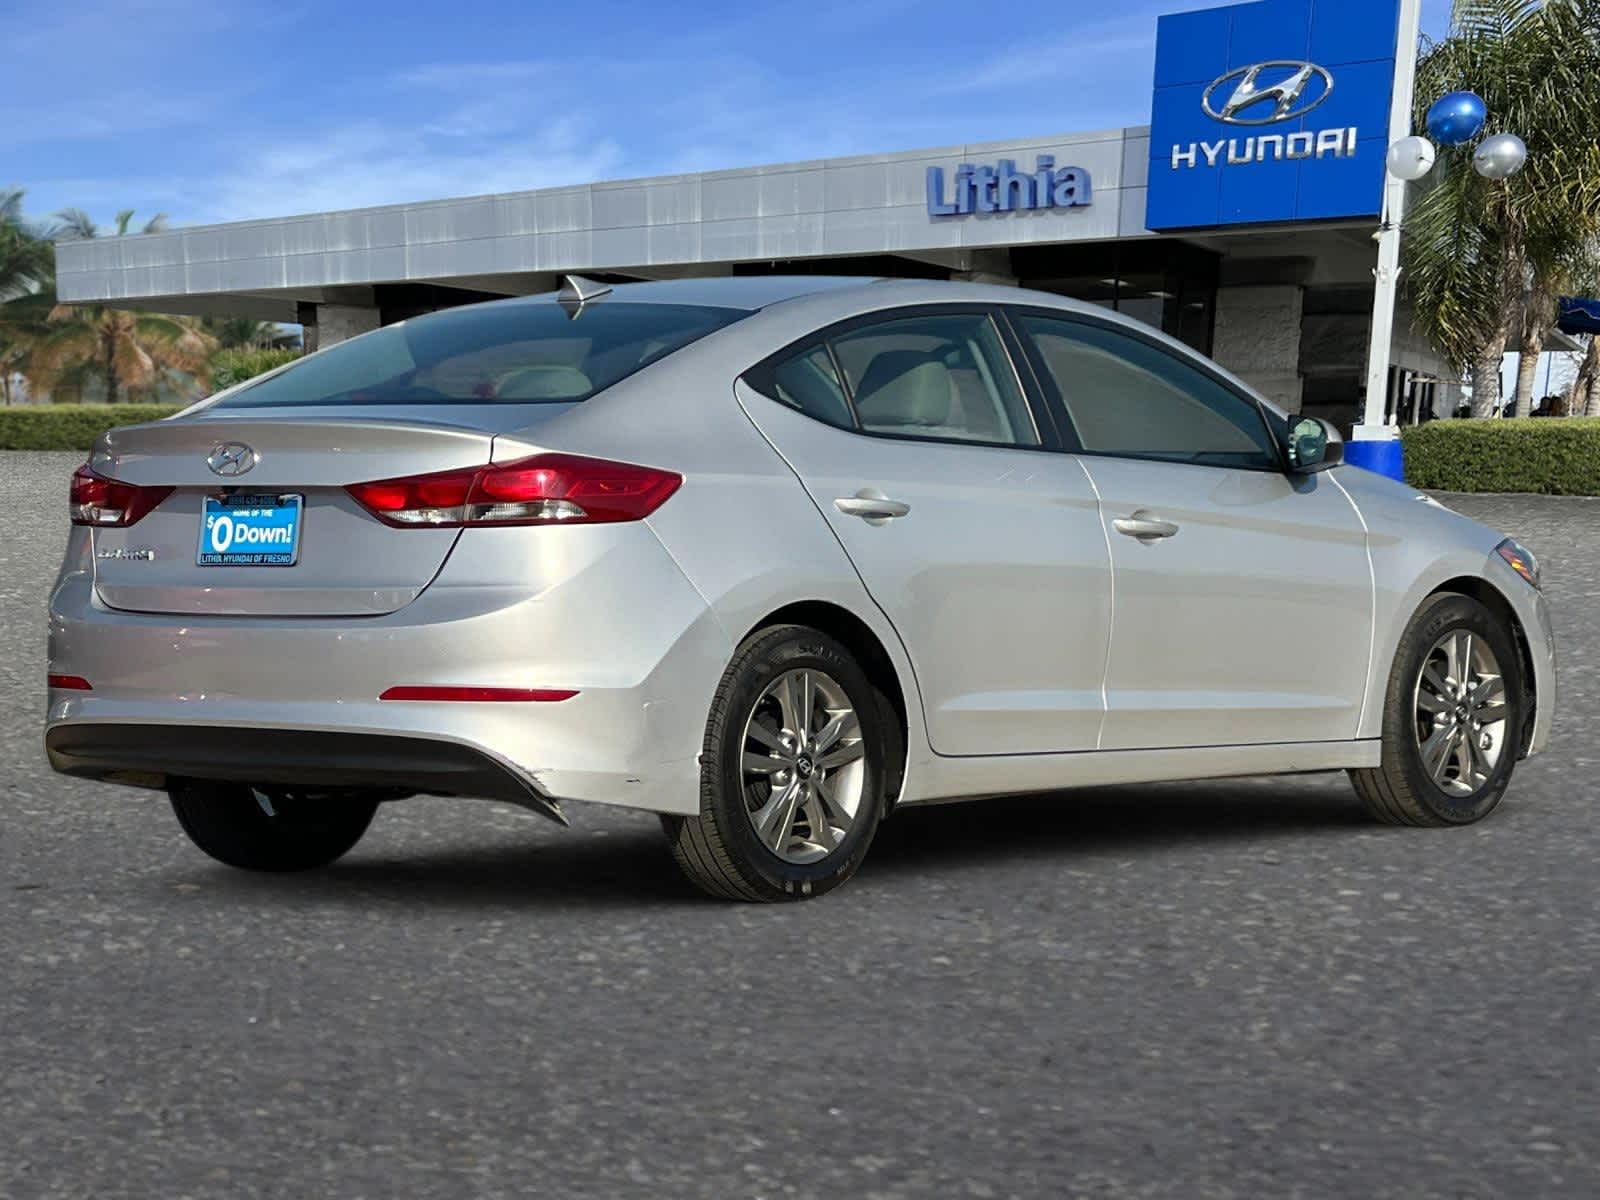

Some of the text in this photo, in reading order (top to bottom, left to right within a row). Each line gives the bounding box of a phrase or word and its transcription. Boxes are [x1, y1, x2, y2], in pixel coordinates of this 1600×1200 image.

[1171, 127, 1357, 169] HYUNDAI
[926, 154, 1092, 216] Lithia
[251, 509, 260, 517] OF
[261, 509, 273, 517] THE
[234, 523, 293, 543] Down!
[223, 554, 253, 563] HYUNDAI
[253, 554, 263, 563] OF
